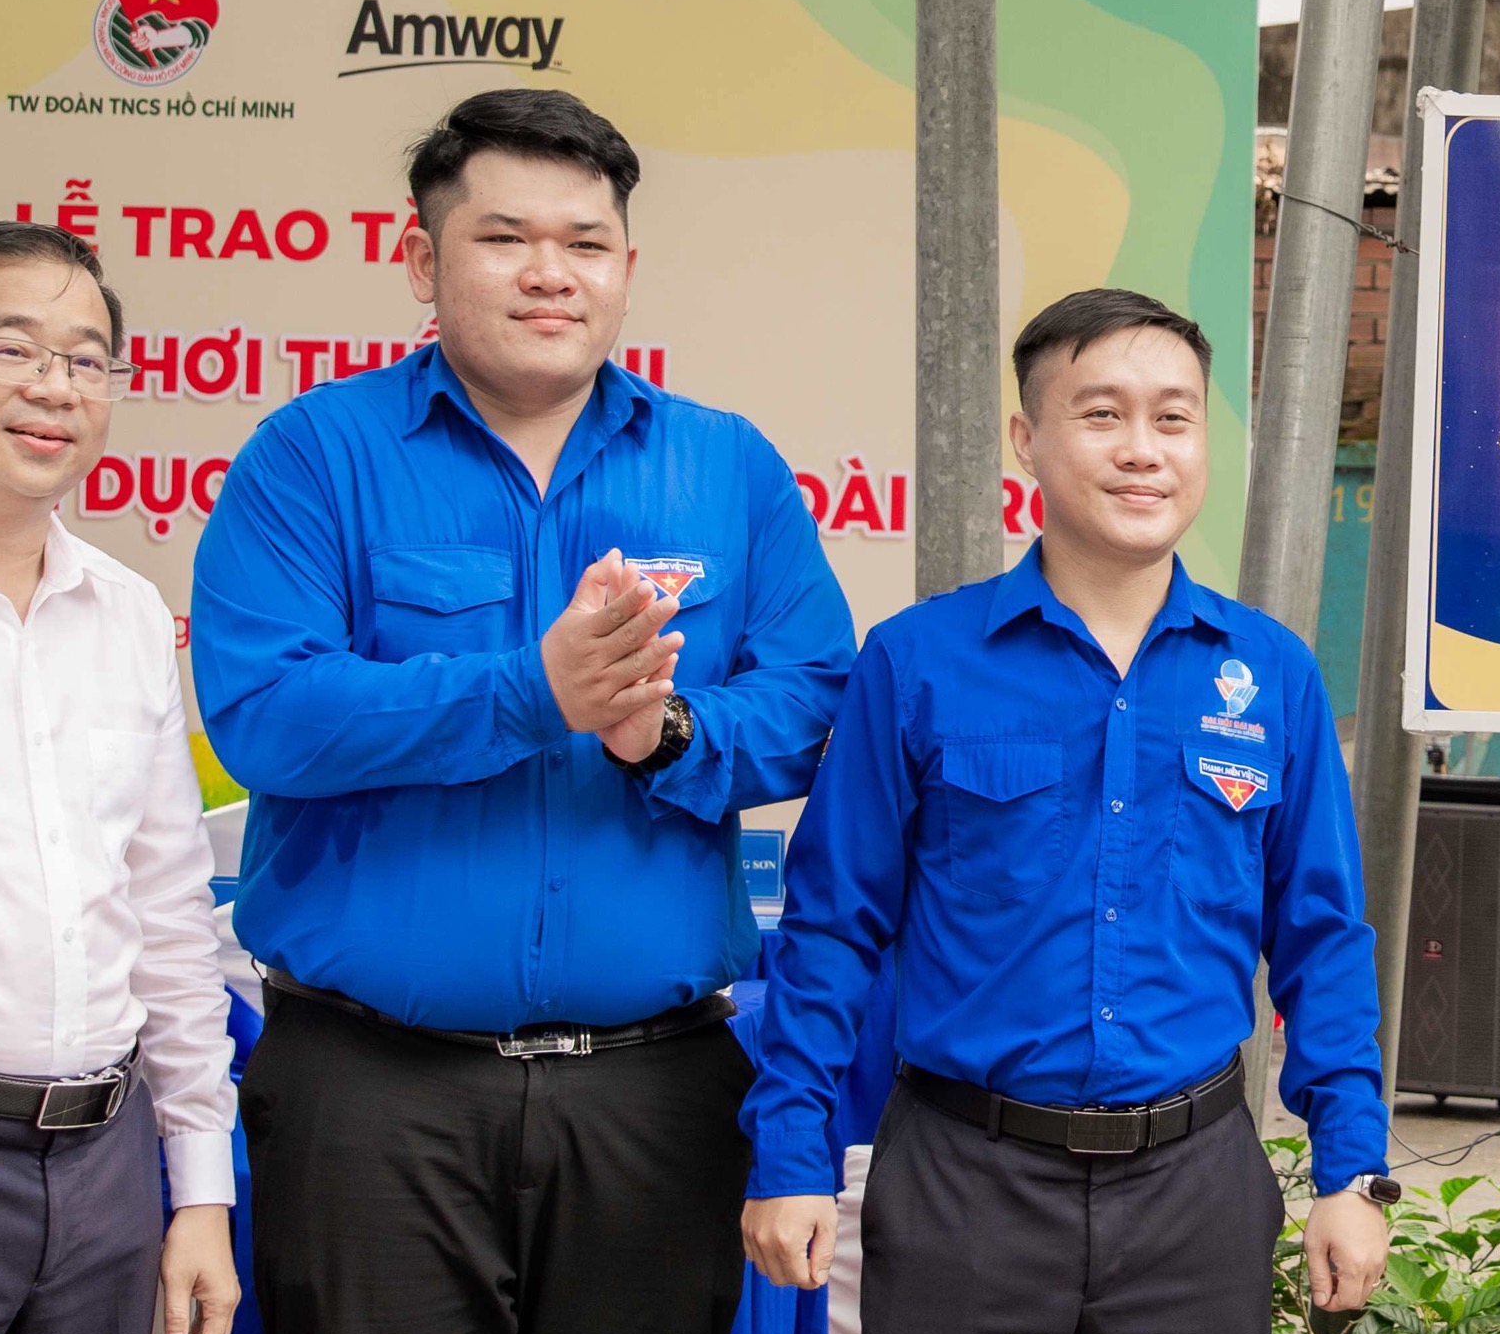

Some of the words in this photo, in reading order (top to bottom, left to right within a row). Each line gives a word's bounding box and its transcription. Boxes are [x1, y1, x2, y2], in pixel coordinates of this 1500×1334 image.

[7, 95, 40, 112] TW
[45, 92, 103, 114] ĐOÀN
[109, 98, 161, 116] TNCS
[167, 91, 196, 116] HỒ
[202, 96, 236, 117] CHÍ
[242, 101, 295, 118] MINH
[122, 206, 330, 262] TRAO
[130, 327, 263, 396] HƠI
